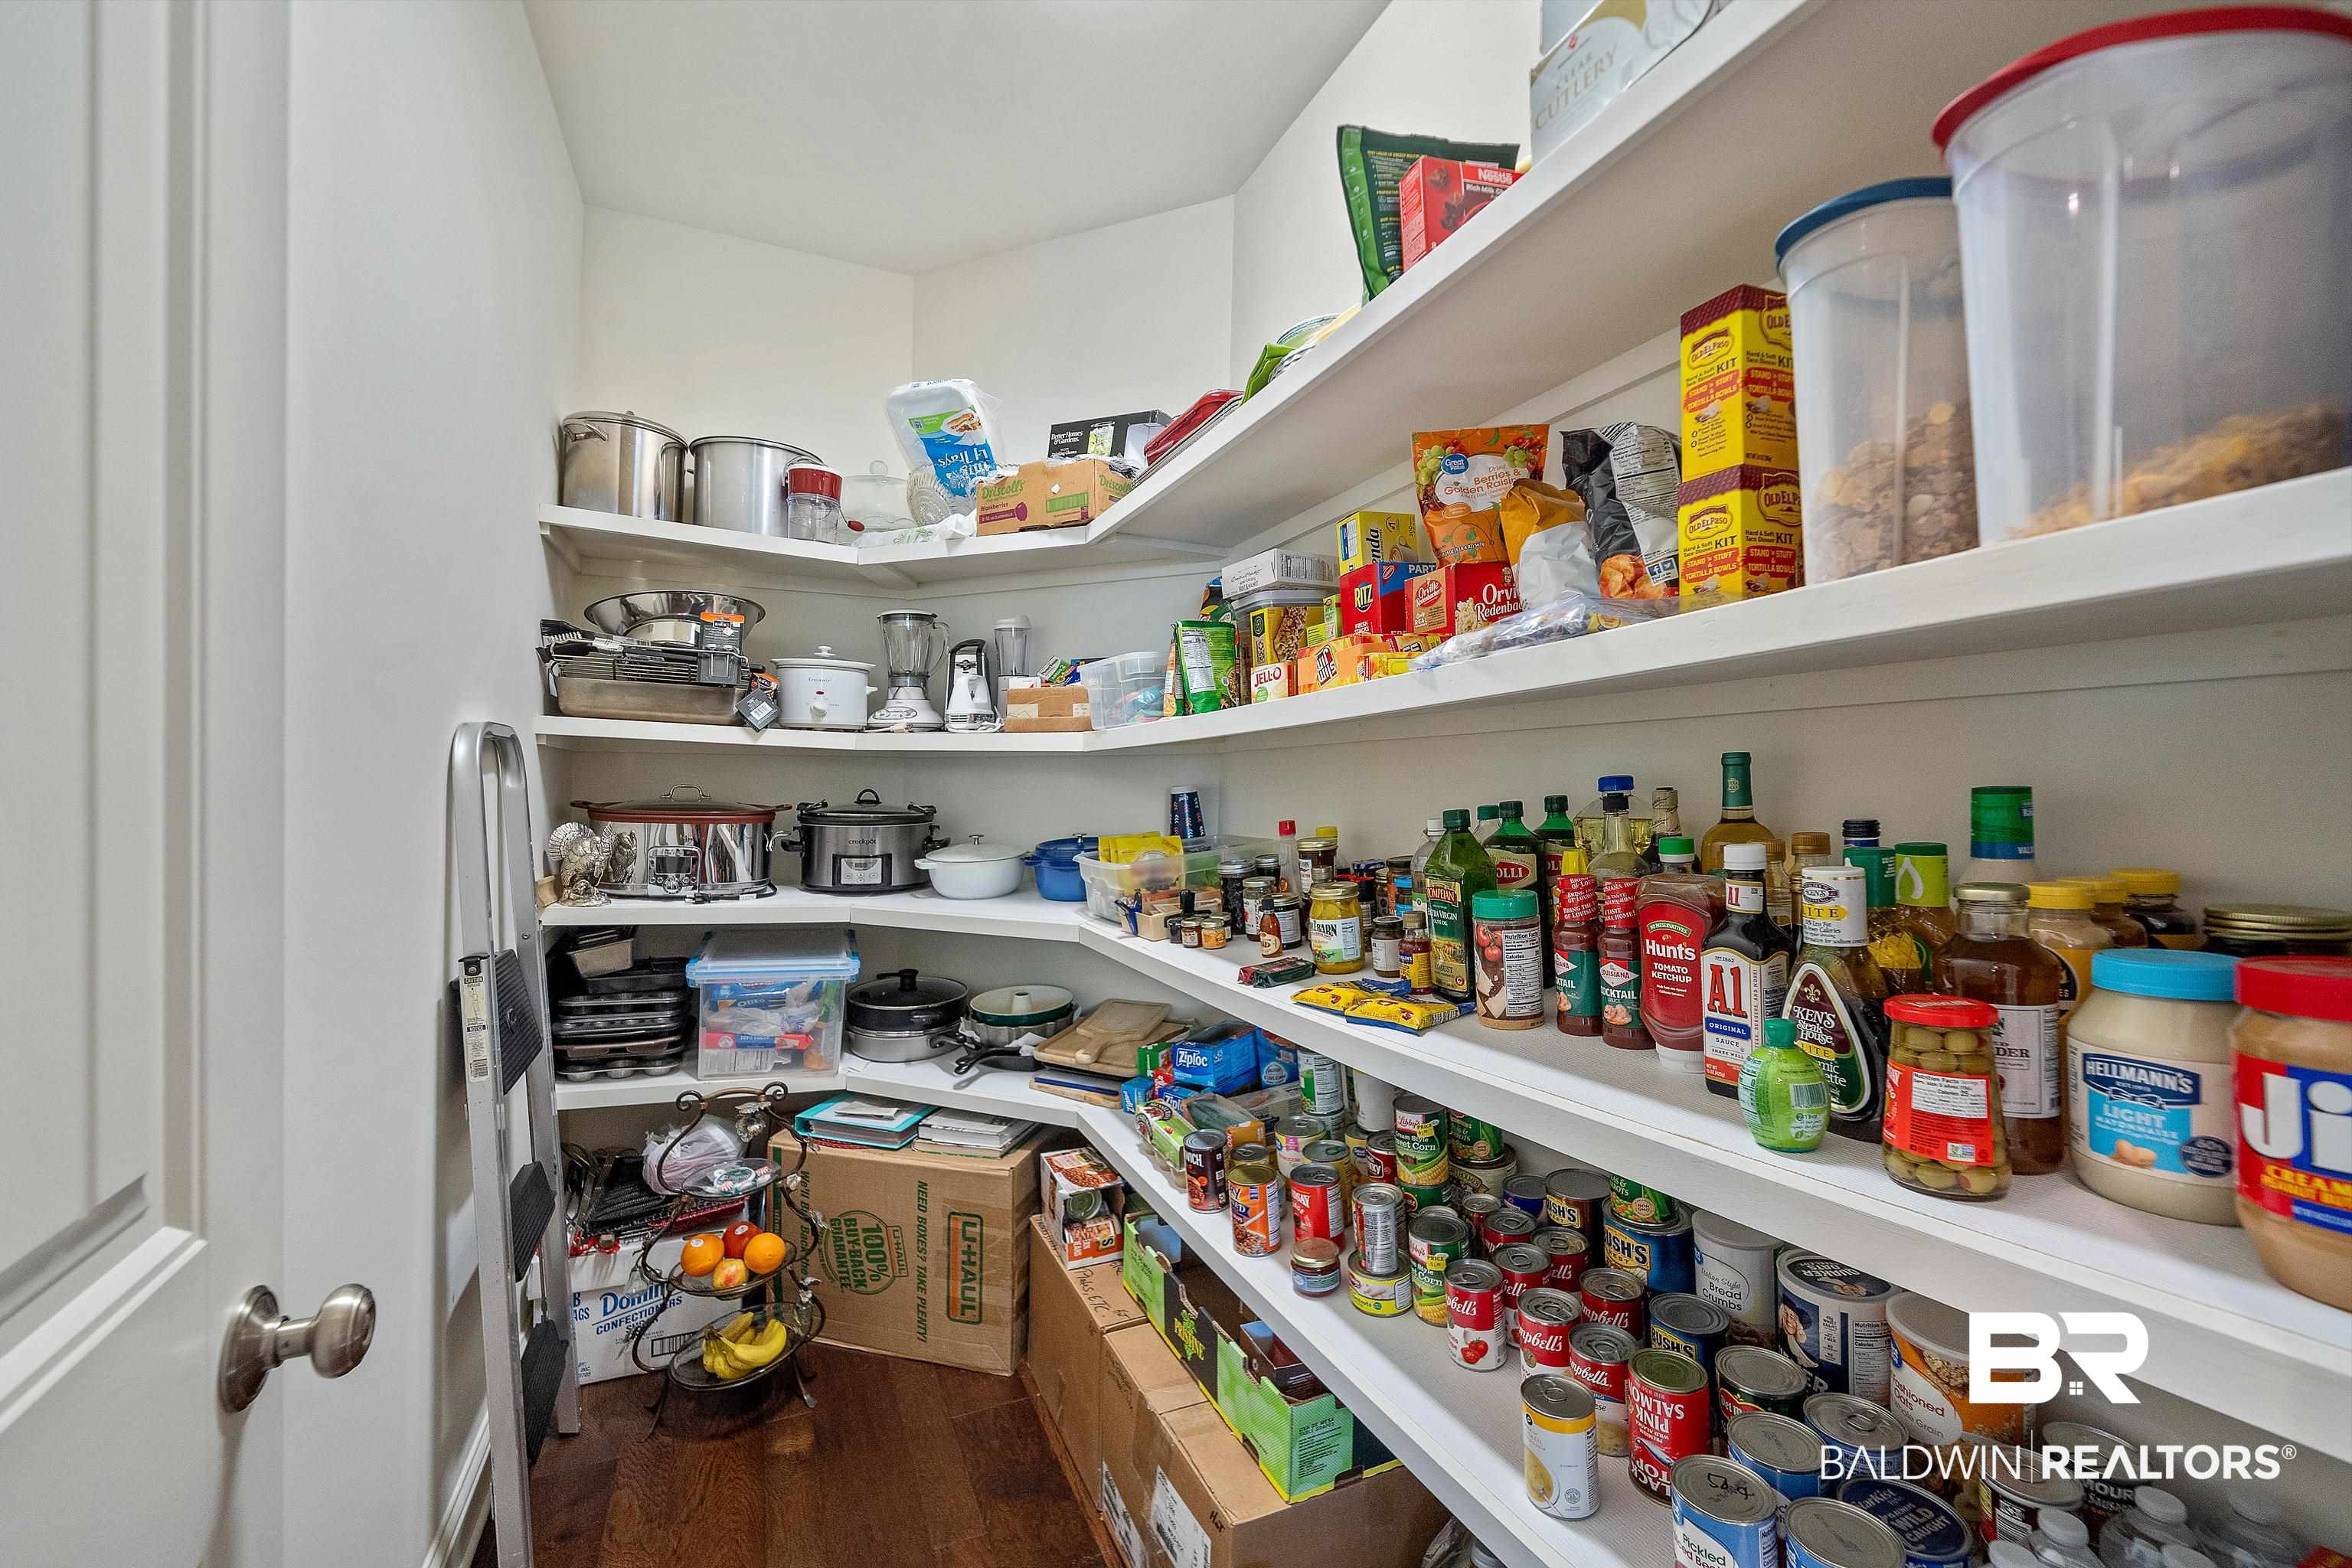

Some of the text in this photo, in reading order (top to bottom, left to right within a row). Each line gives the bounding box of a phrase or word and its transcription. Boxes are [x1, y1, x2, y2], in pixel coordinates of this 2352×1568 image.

[1535, 43, 1618, 129] CUTLERY
[1717, 357, 1738, 374] KIT
[1474, 471, 1511, 485] Berries
[1444, 485, 1485, 495] Golden
[1764, 492, 1780, 507] OLD
[1689, 522, 1701, 534] OLD
[1714, 534, 1738, 549] KIT
[1775, 532, 1794, 544] KIT
[1714, 550, 1733, 561] STUFF
[1685, 562, 1737, 580] TORTILLA BOWLS
[1748, 563, 1775, 572] TORTILLA
[1354, 583, 1374, 608] RITZ
[1418, 581, 1439, 599] Orville
[1439, 910, 1458, 920] VIRGIN
[1563, 906, 1581, 915] BRING
[1504, 931, 1530, 940] Nutrition
[1645, 939, 1697, 962] Hunt's
[1601, 968, 1630, 980] LOUISIANA
[1653, 962, 1689, 975] TOMATO
[1651, 971, 1693, 985] KETCHUP
[1793, 1006, 1836, 1029] KEN'S
[1709, 1022, 1746, 1035] ORIGINAL
[1796, 1019, 1823, 1034] Steak
[1715, 1037, 1740, 1047] SAUCE
[1799, 1028, 1834, 1044] House
[1178, 1051, 1208, 1067] Ziploc
[2085, 1060, 2194, 1095] HELLMANN'S
[2103, 1104, 2167, 1128] LIGHT
[1411, 1135, 1429, 1144] Style
[1413, 1141, 1436, 1152] Corn
[844, 1217, 867, 1288] BUY-BACK
[862, 1220, 890, 1282] 100%
[916, 1180, 929, 1343] NEED BOXES? TAKE PLENTY!
[1418, 1272, 1443, 1287] Corn
[1708, 1281, 1742, 1301] Bread
[1702, 1288, 1743, 1312] Crumbs
[1893, 1388, 1913, 1412] Oats
[1636, 1404, 1670, 1433] PINK
[1916, 1419, 1944, 1439] Grain
[1890, 1507, 1936, 1530] WILD
[1683, 1533, 1726, 1566] Pickled
